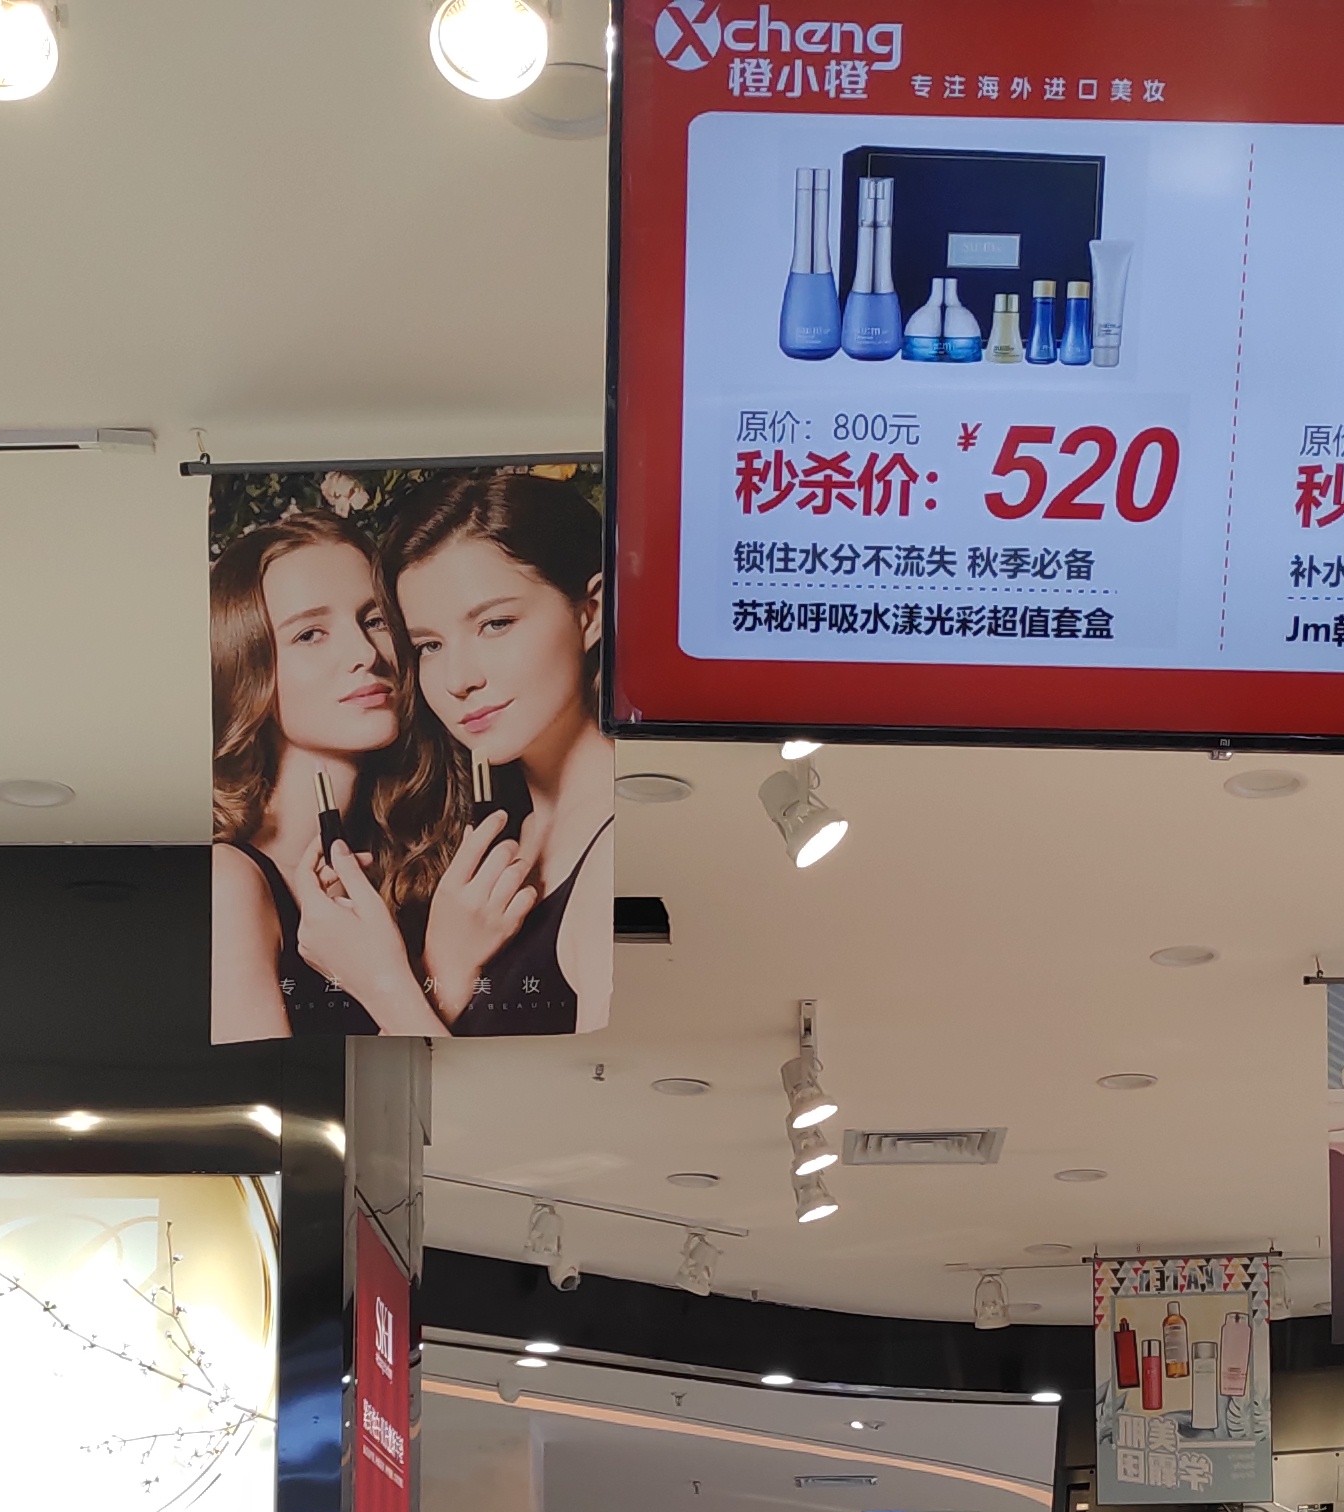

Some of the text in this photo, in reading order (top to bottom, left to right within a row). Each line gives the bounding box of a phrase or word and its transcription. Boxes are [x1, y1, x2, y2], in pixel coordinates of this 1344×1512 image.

[729, 58, 868, 100] 橙小橙
[910, 74, 1166, 103] 专注海外进口美妆
[733, 541, 1095, 581] 锁住水分不流失 秋季必备
[732, 600, 1113, 640] 苏秘呼吸水漾光彩超值套盒
